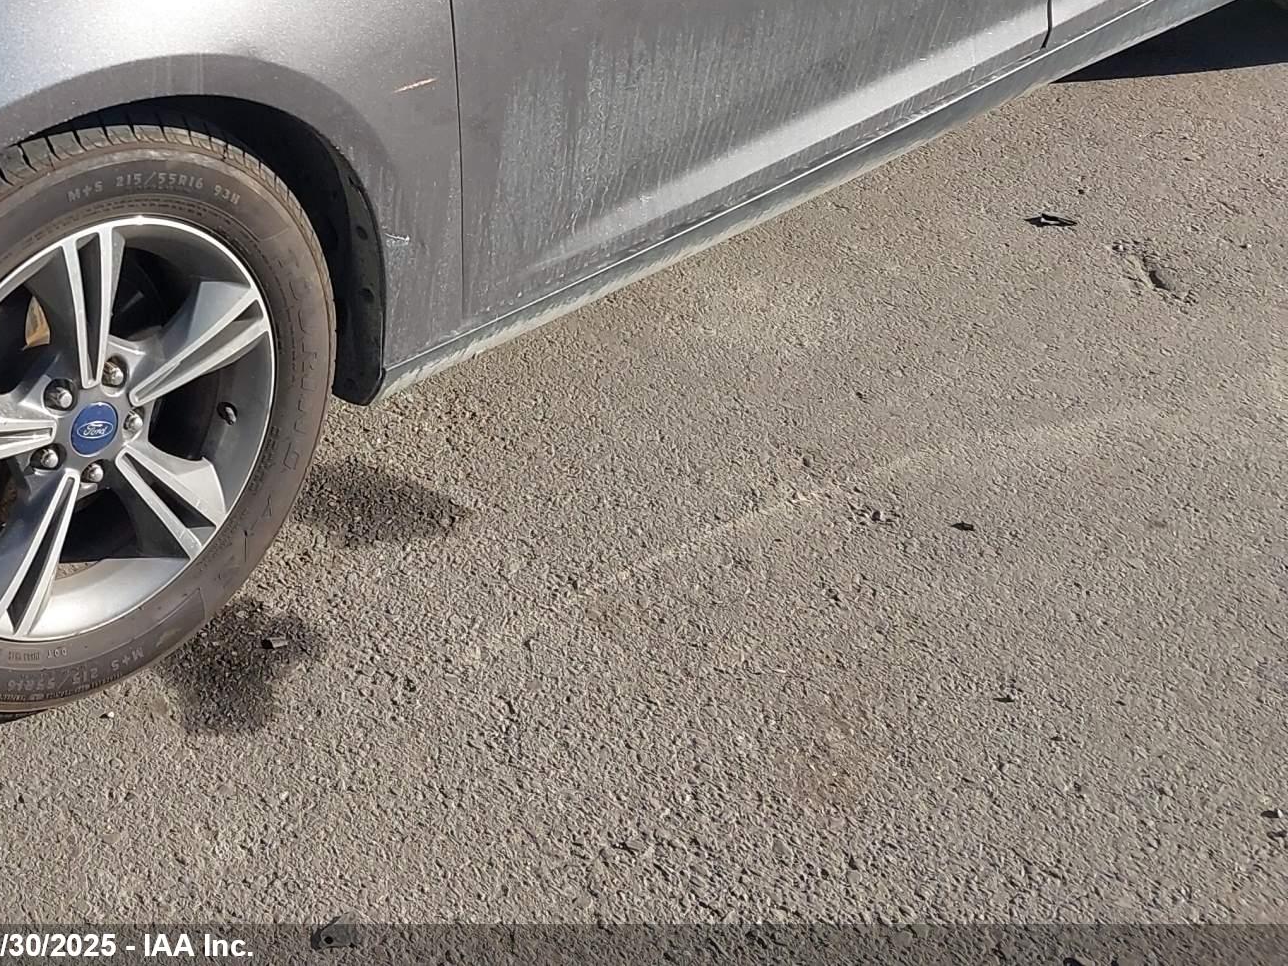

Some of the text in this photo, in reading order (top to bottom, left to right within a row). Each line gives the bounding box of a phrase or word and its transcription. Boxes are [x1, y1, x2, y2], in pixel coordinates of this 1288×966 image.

[67, 180, 104, 203] M+S
[115, 170, 204, 191] 215/55R16
[213, 184, 241, 205] 93H
[81, 422, 110, 436] Ford
